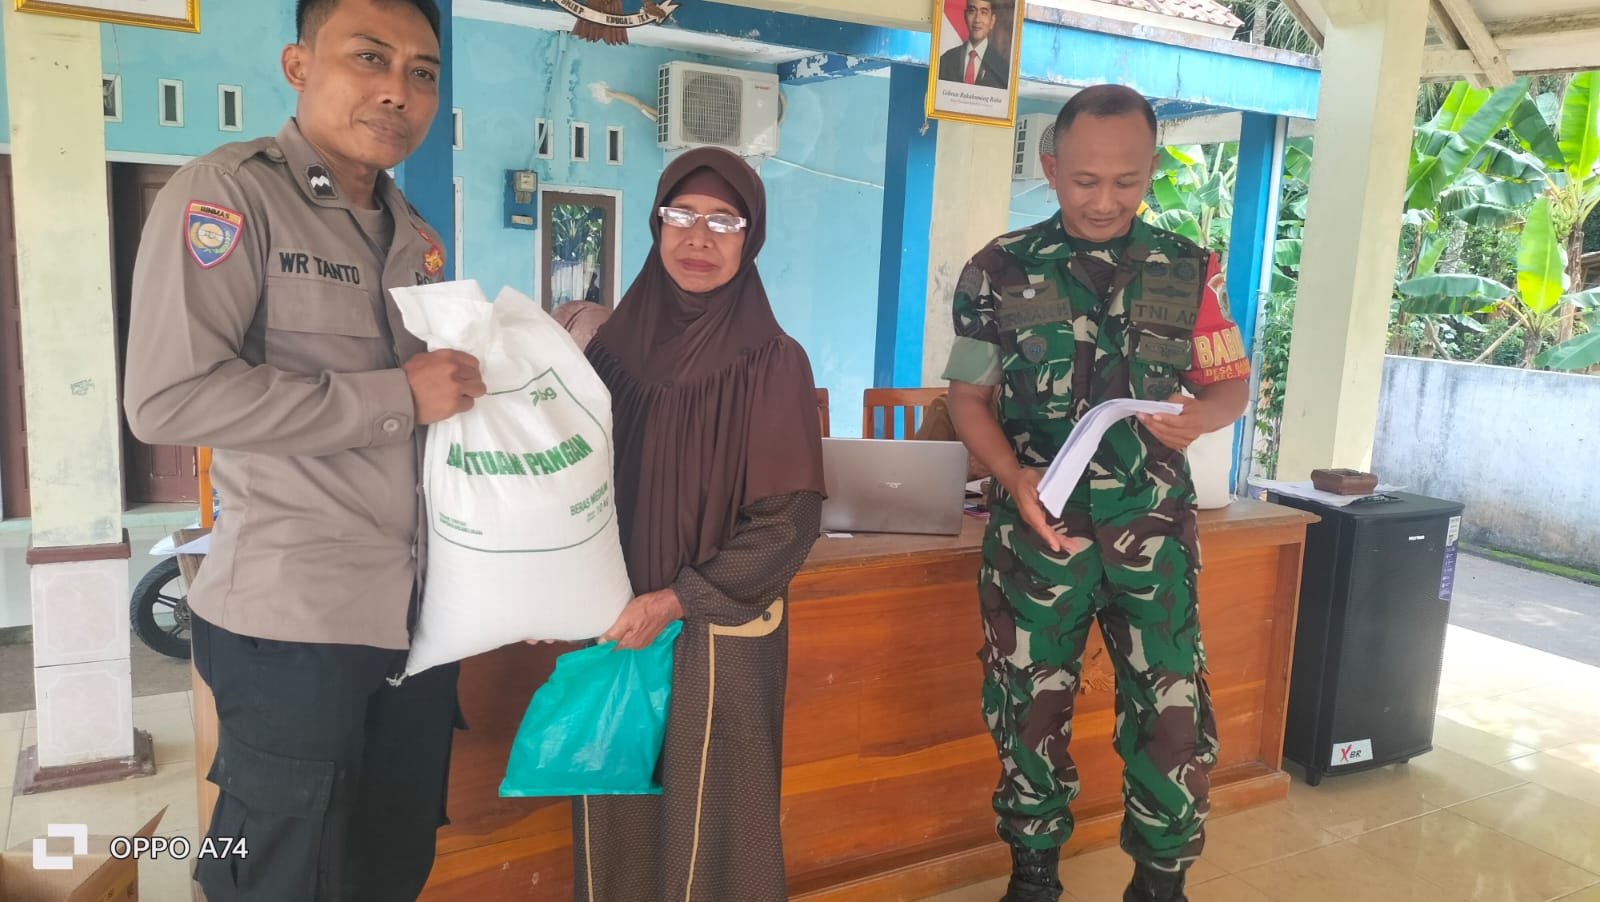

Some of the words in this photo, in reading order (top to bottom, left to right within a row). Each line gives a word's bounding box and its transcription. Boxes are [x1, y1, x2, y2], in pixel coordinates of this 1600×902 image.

[279, 252, 309, 274] WR
[314, 256, 360, 285] TANTO
[1135, 304, 1168, 320] TNI
[522, 433, 593, 475] PANGAN
